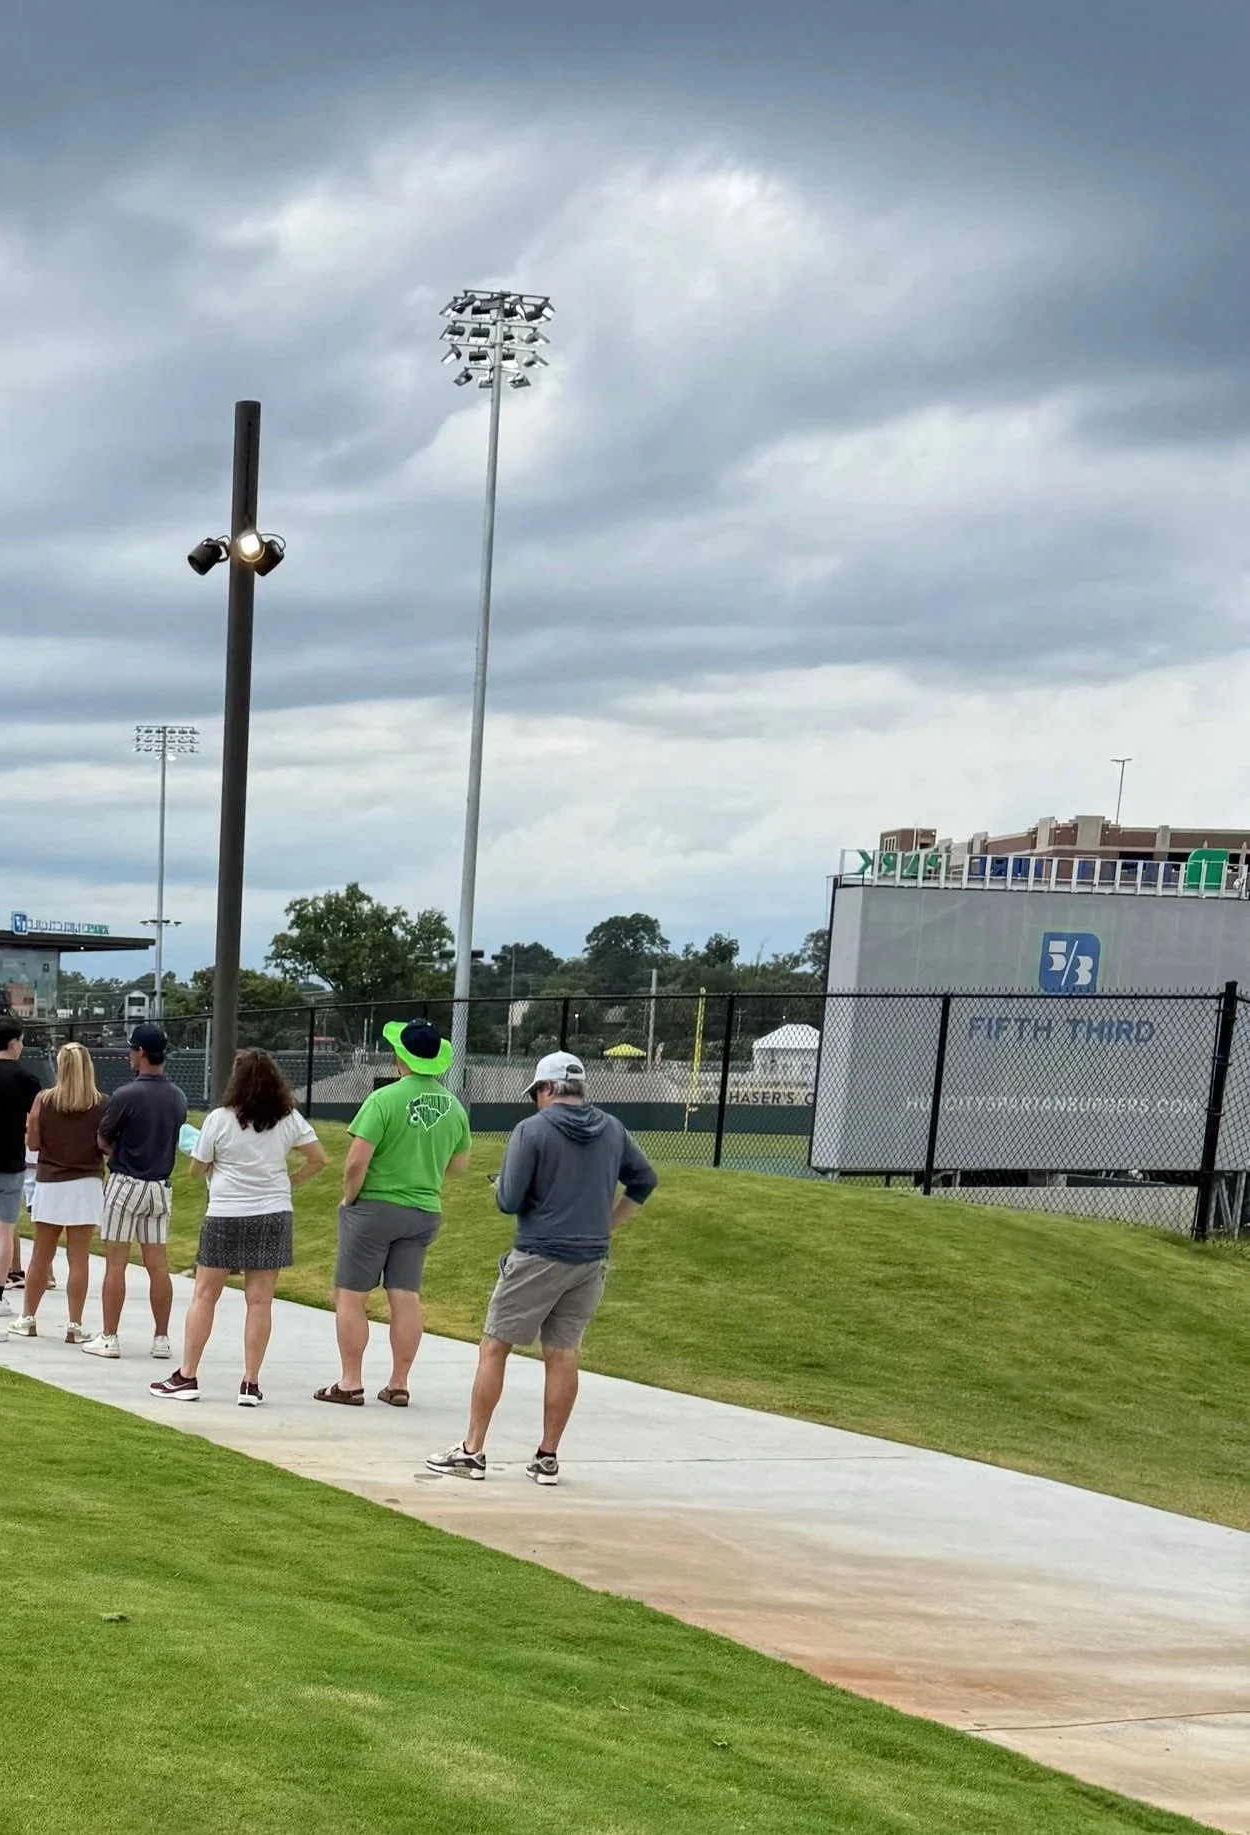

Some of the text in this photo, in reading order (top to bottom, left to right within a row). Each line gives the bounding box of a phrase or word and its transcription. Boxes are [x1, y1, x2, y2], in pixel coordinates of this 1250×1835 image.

[969, 1016, 1155, 1044] FIFTH THIRD
[724, 1090, 795, 1105] HASER'S
